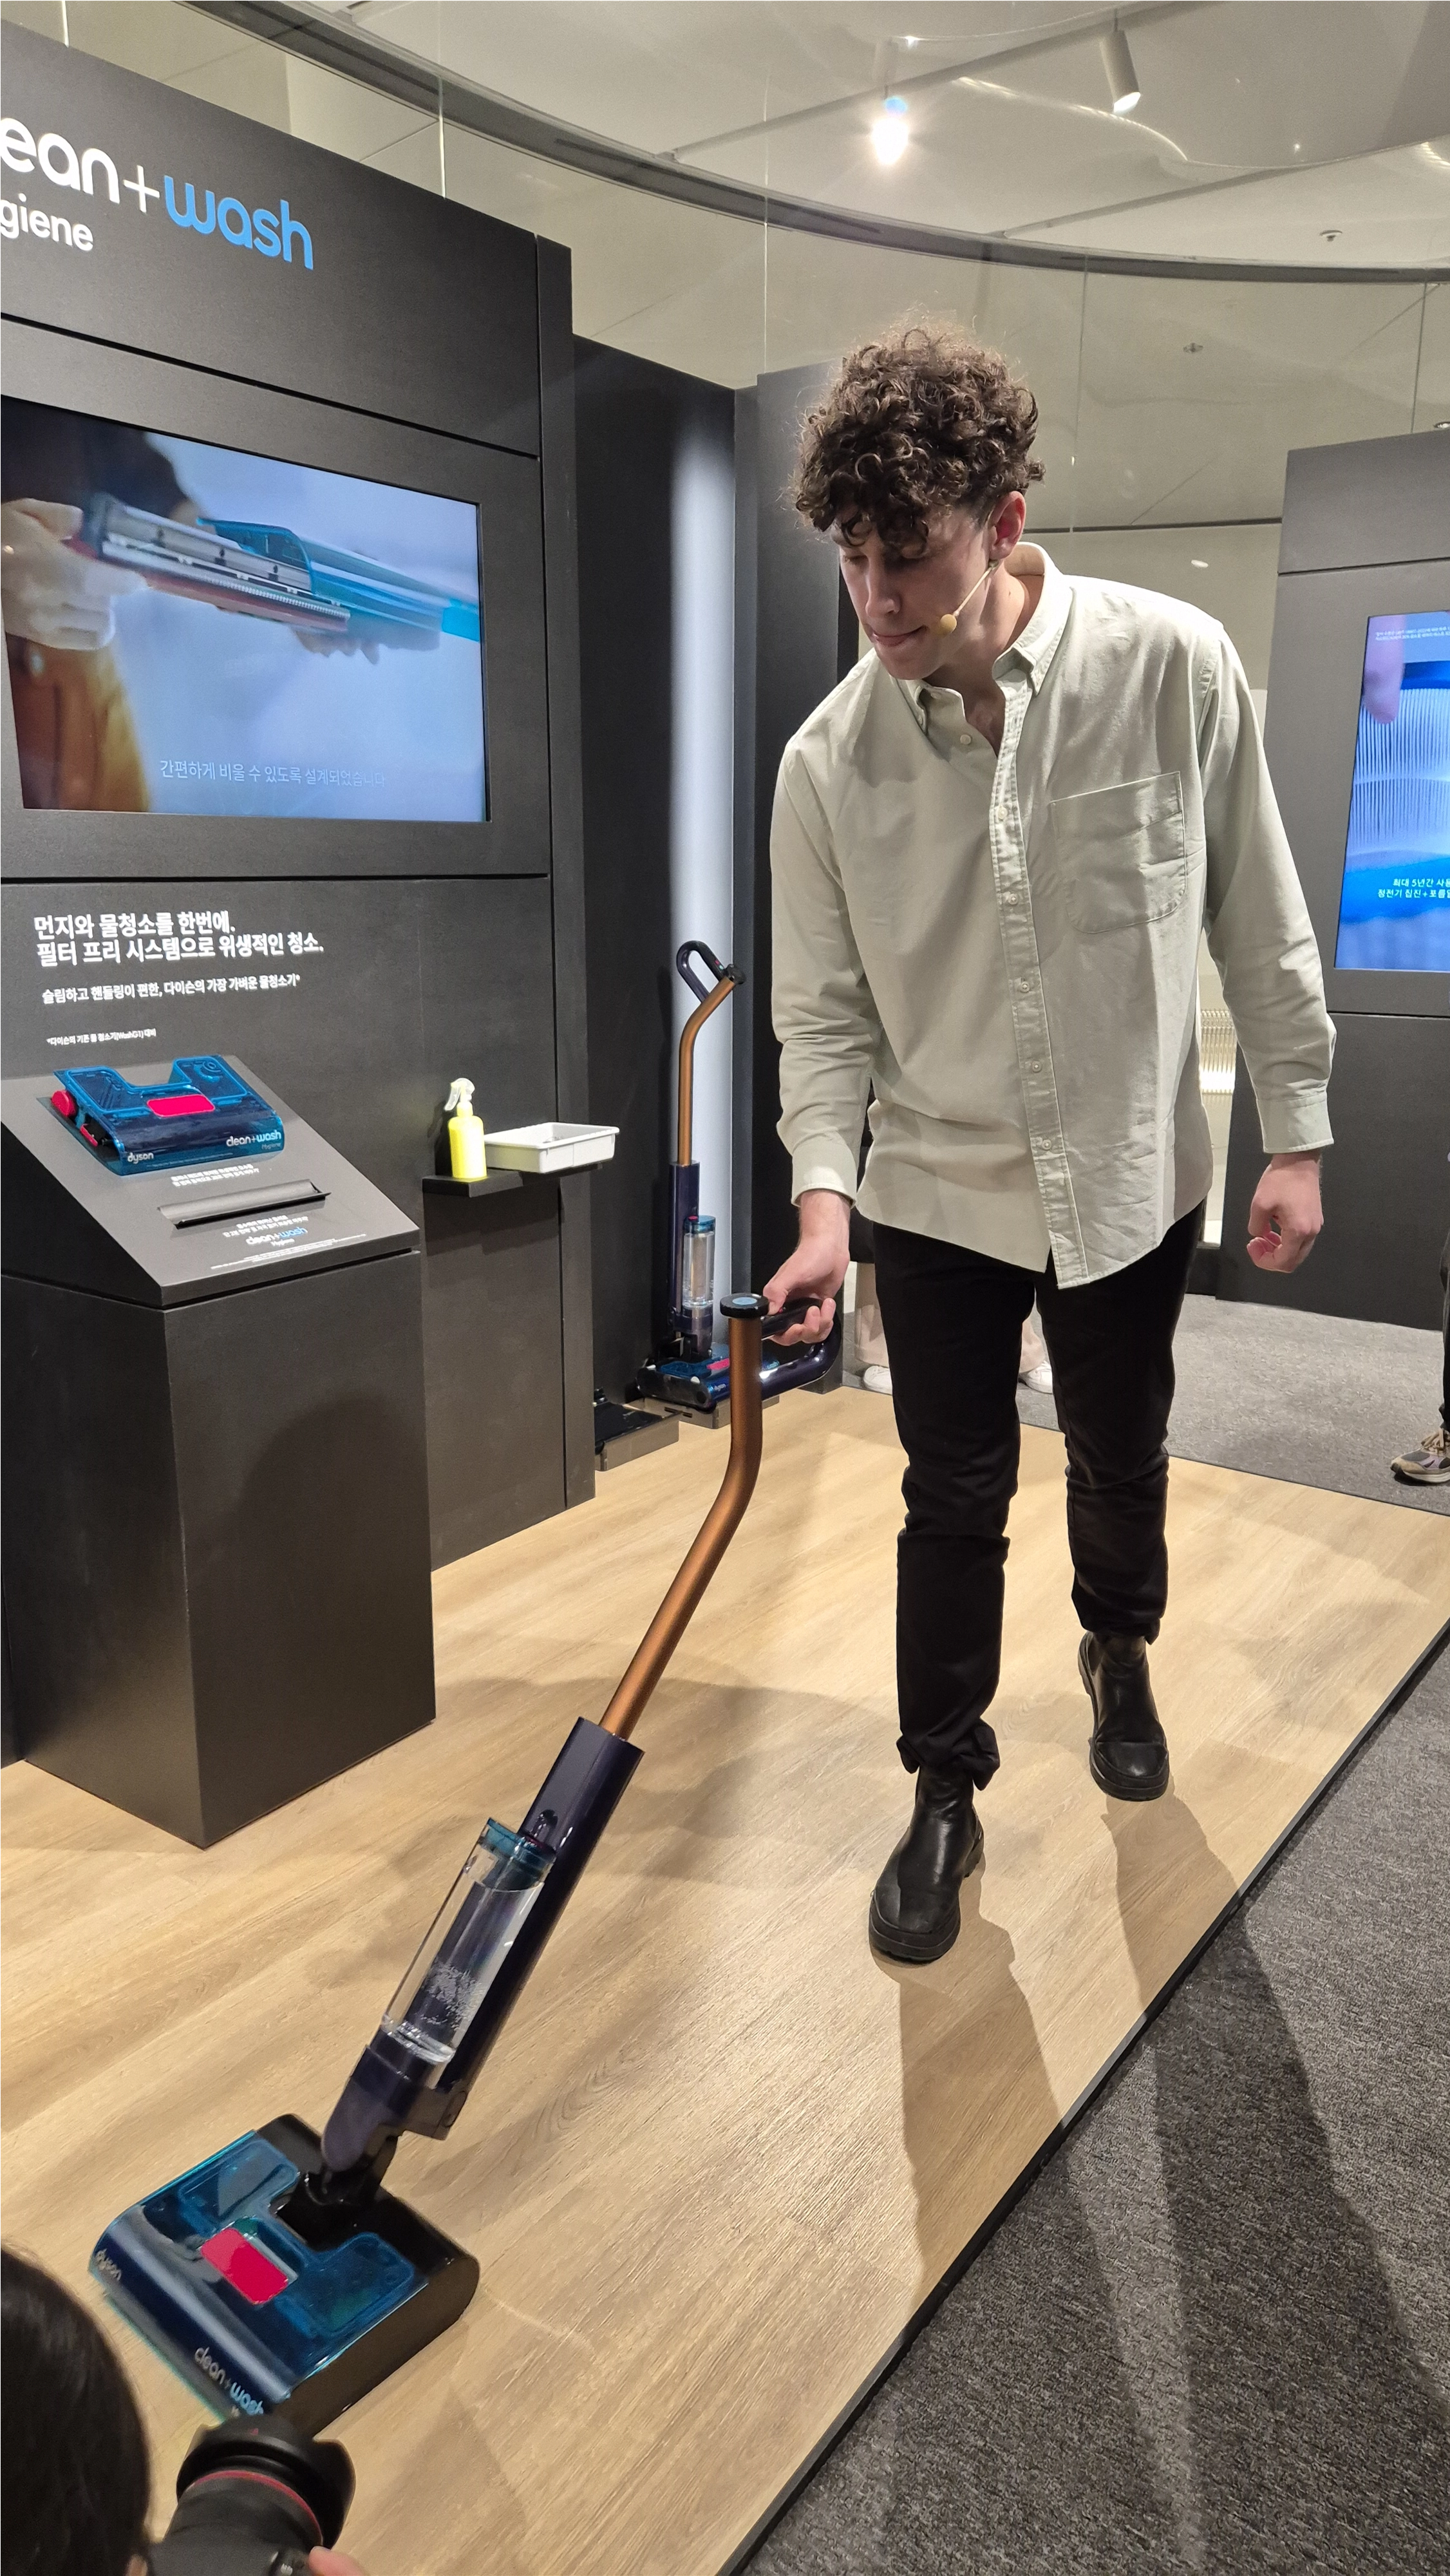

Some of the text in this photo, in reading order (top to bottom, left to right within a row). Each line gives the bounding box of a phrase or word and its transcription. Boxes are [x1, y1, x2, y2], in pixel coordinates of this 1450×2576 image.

[160, 759, 385, 787] 간편하게 비울 수 있도록 설계되었습니다
[1411, 878, 1434, 887] 5년간
[34, 910, 236, 940] 먼지와 물청소를 한번에.
[37, 931, 324, 967] 필터 프리 시스템으로 위생적인 청소.
[42, 988, 89, 1004] 슬림하고
[90, 983, 136, 1001] 핸들링이
[137, 982, 162, 998] 편한,
[164, 979, 205, 996] 다이슨의
[206, 977, 227, 993] 가장
[228, 975, 258, 991] 가벼운
[127, 1152, 154, 1164] dyson
